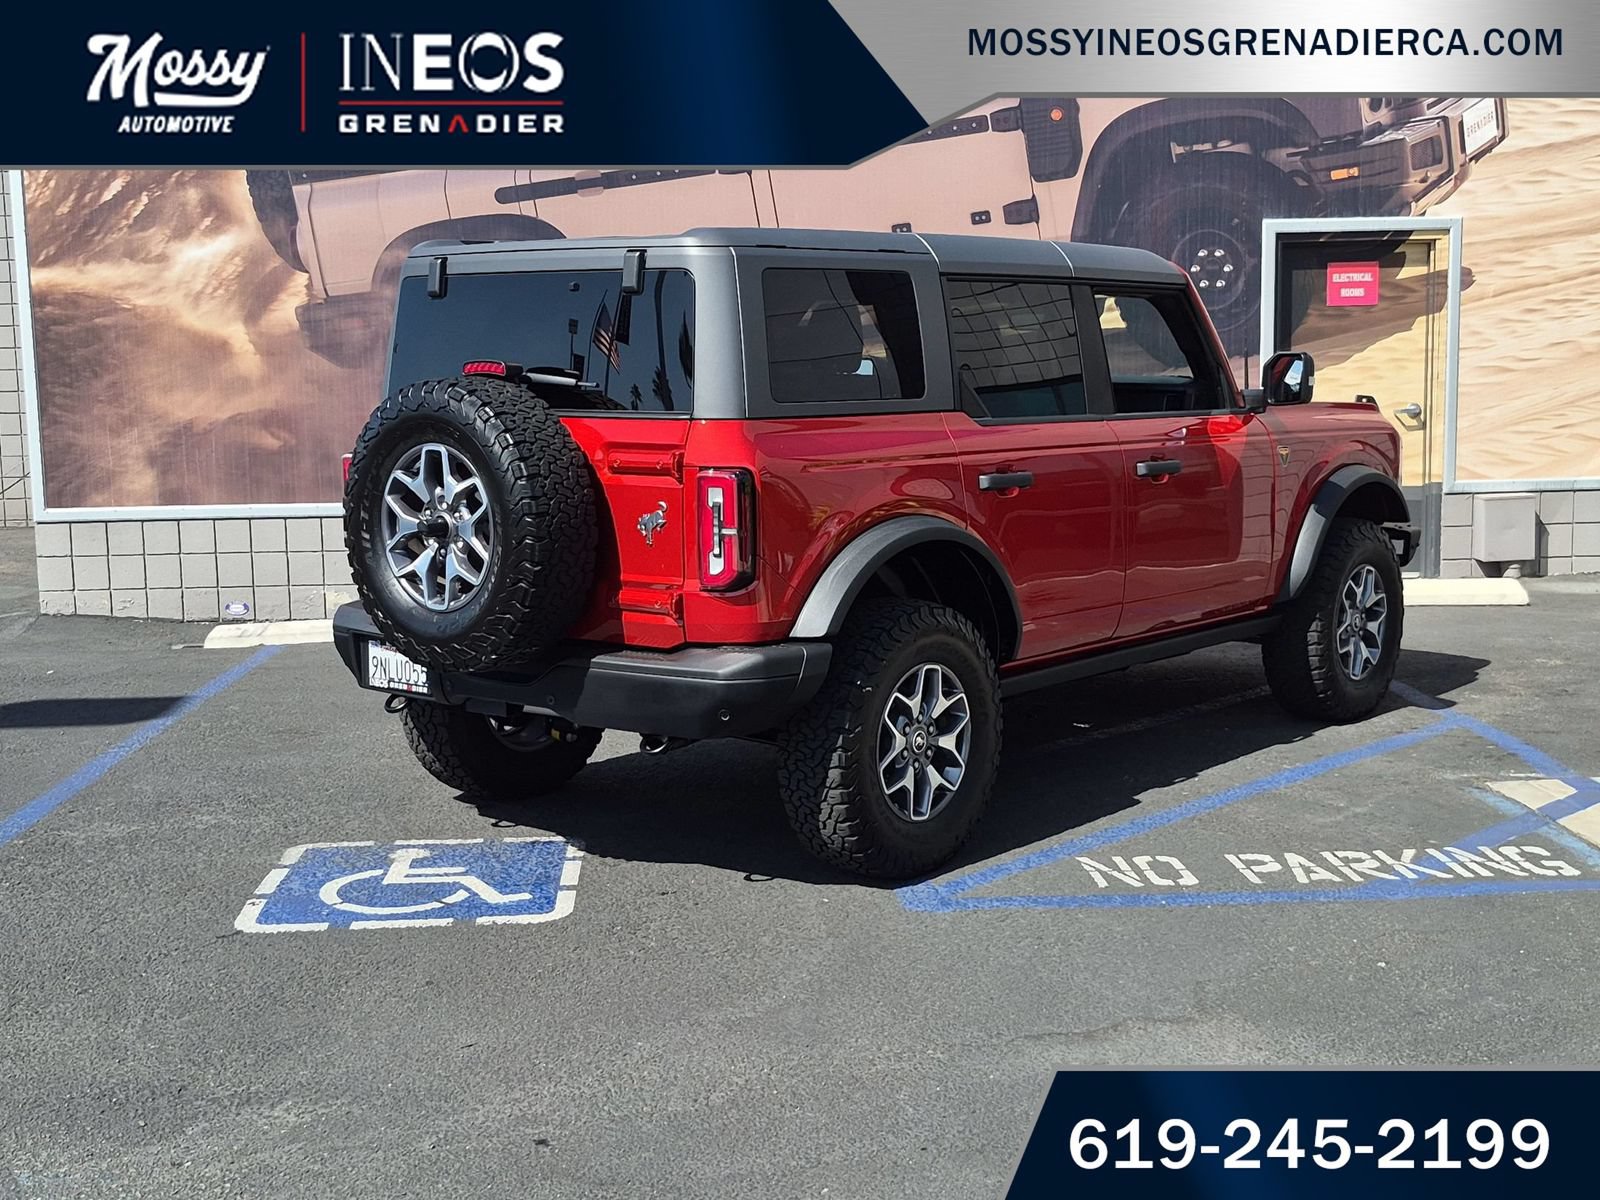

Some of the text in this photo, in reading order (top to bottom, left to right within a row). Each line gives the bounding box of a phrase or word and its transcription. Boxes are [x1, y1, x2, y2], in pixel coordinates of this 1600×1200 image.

[1332, 272, 1374, 283] ELECTRICAL
[1076, 845, 1582, 888] NO PARKING
